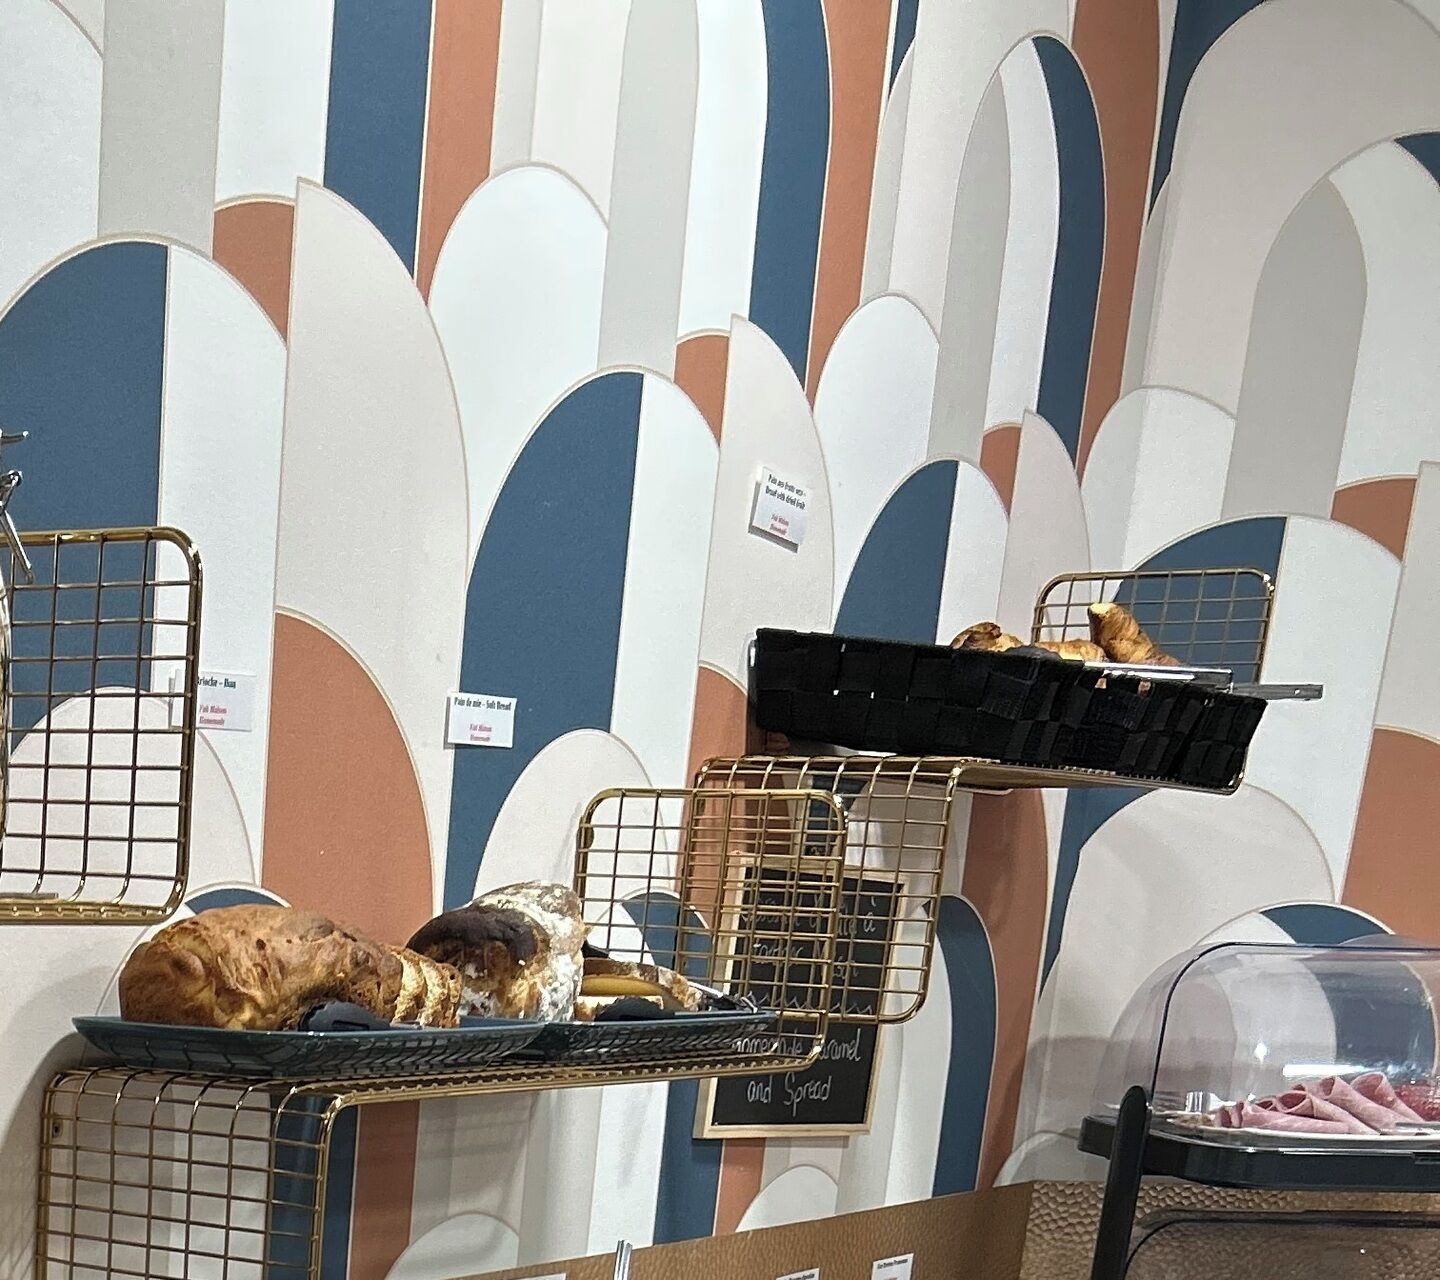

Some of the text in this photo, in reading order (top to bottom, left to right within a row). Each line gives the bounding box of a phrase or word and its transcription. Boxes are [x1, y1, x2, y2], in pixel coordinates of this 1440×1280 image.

[198, 676, 218, 687] rioche
[819, 1027, 862, 1062] aramel
[746, 1074, 773, 1103] and
